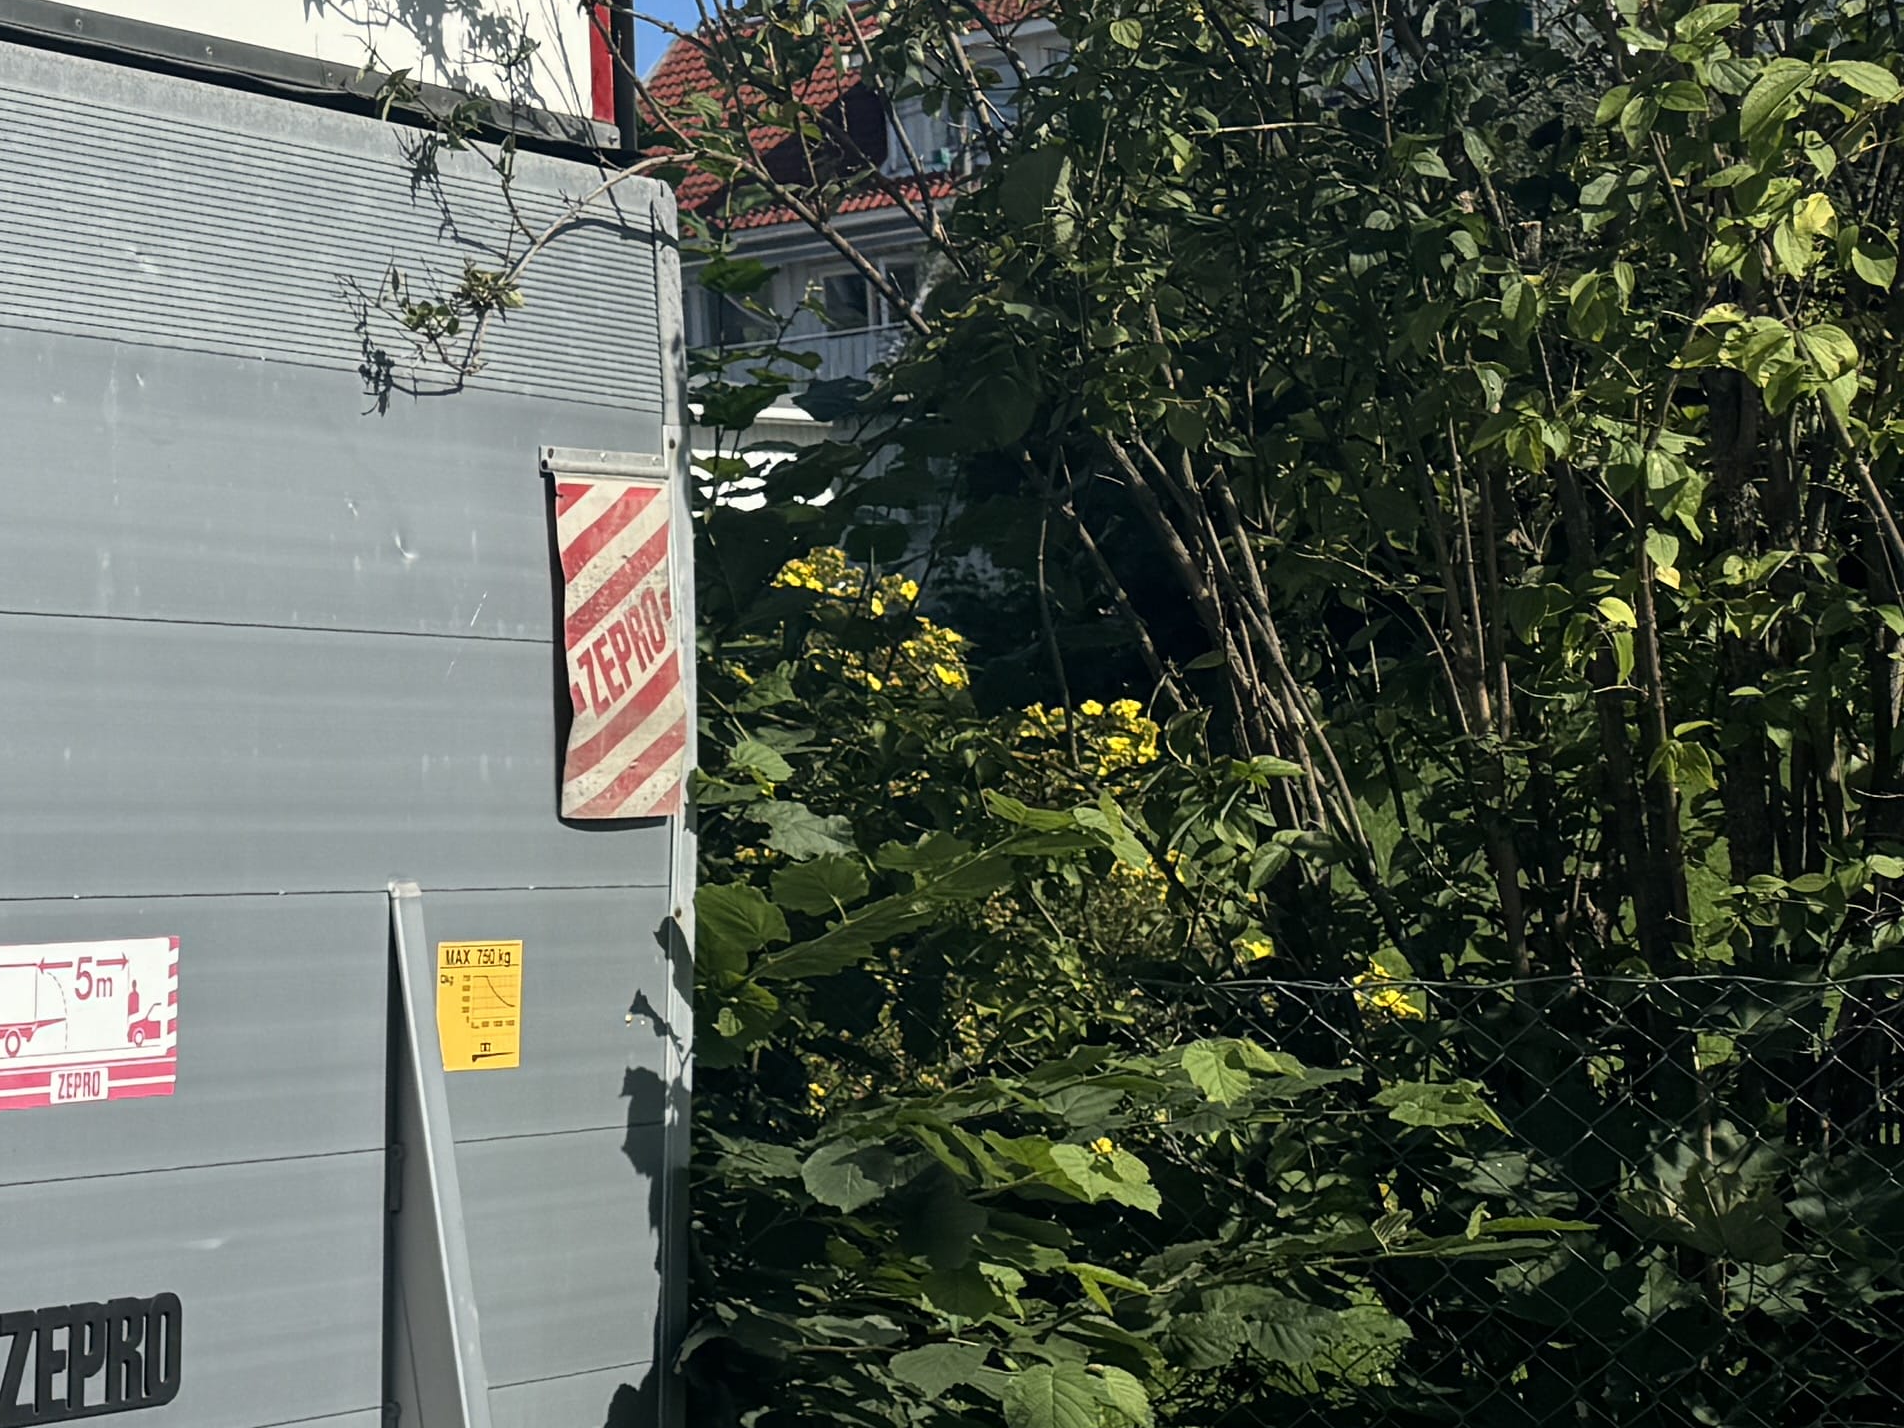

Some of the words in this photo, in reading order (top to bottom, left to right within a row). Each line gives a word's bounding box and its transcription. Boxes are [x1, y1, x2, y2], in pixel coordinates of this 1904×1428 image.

[576, 586, 667, 720] ZEPRO
[446, 949, 471, 965] MAX
[498, 948, 511, 967] kg
[58, 1070, 101, 1100] ZEPRO
